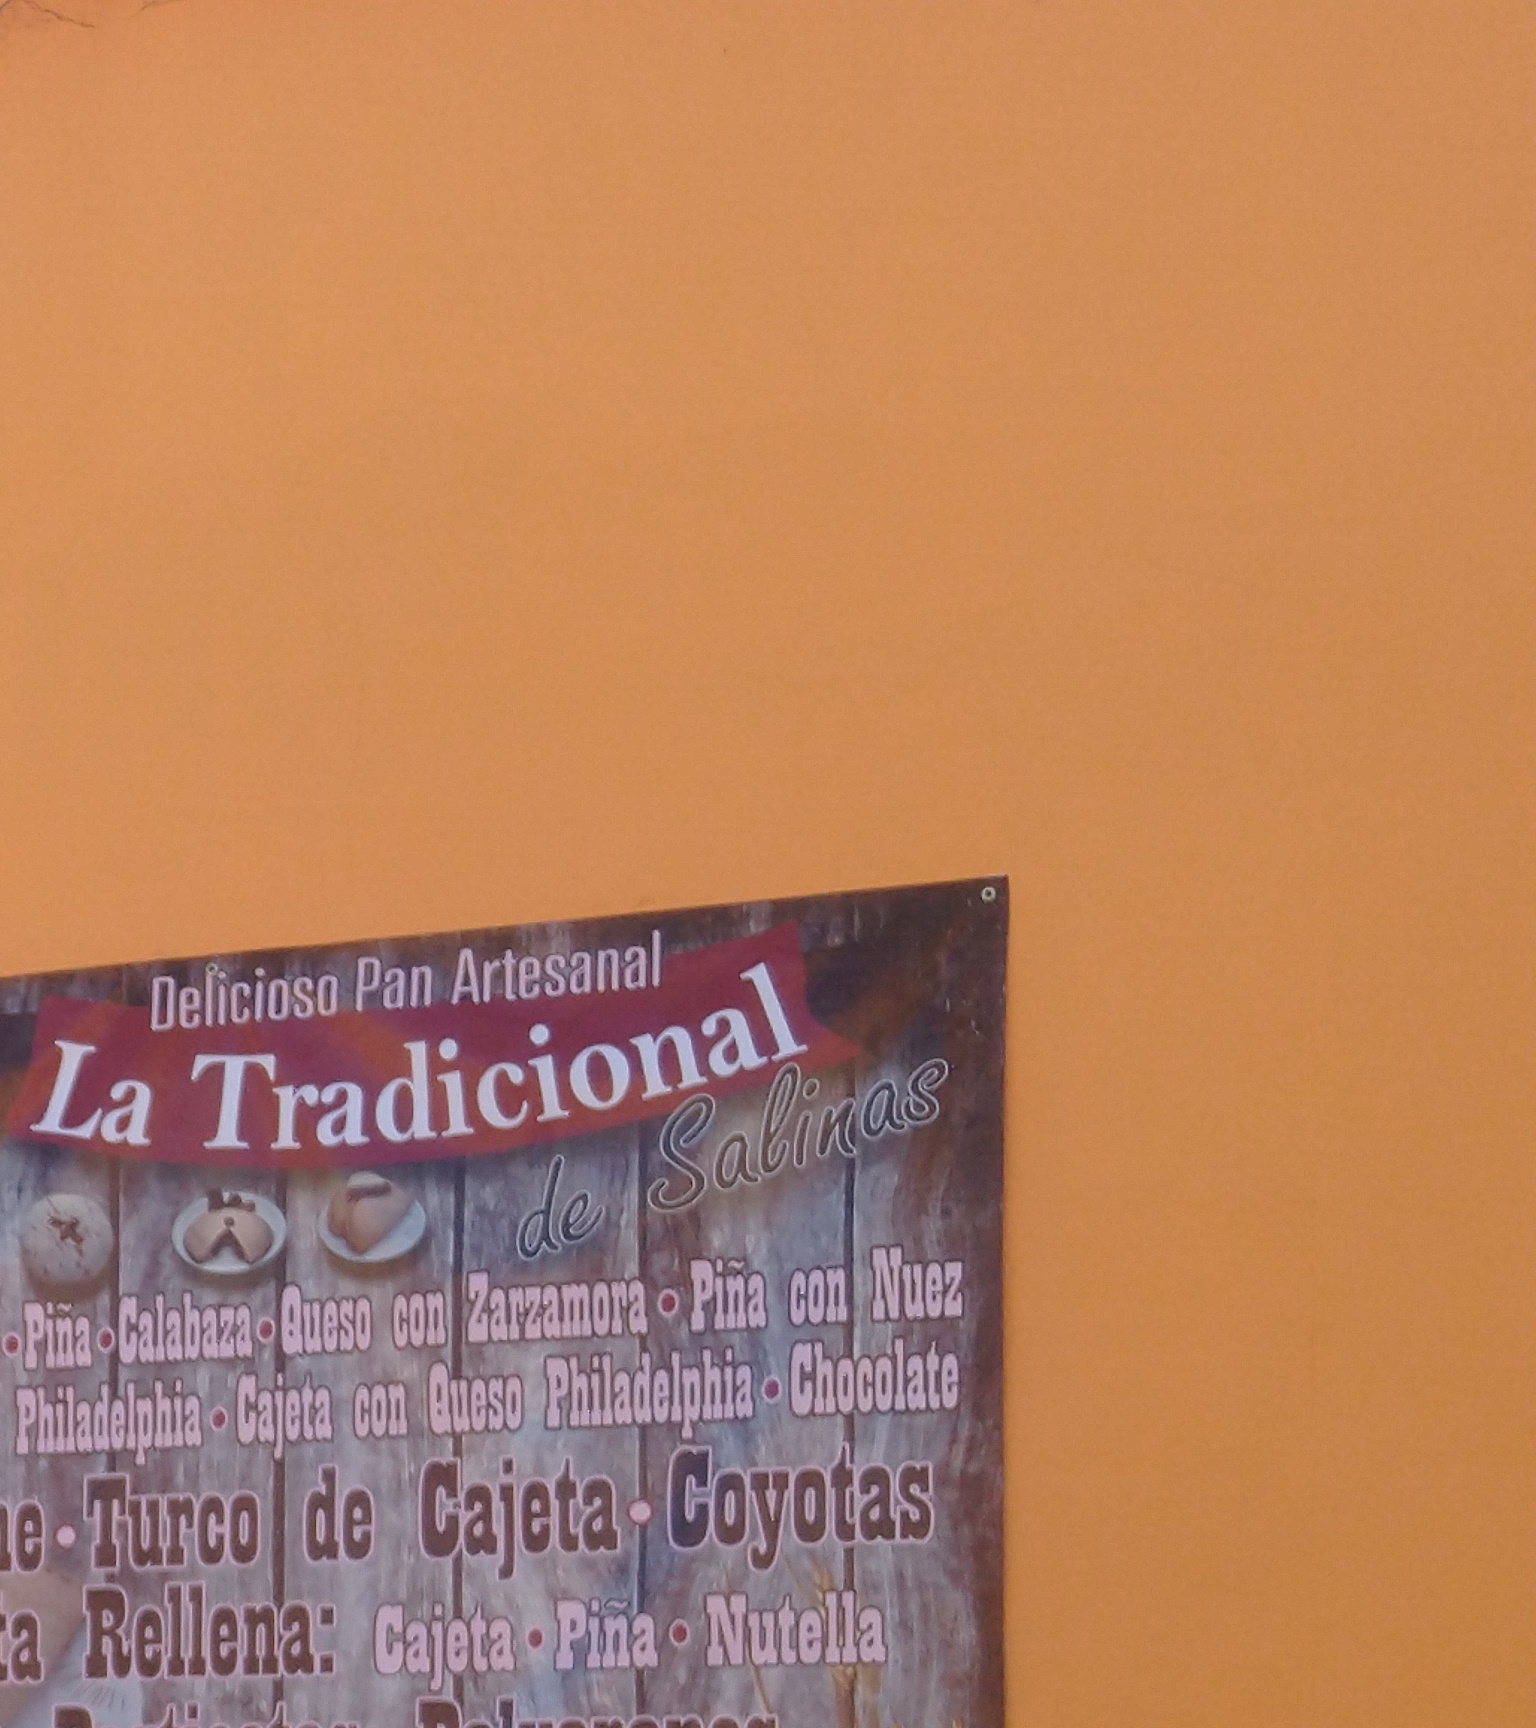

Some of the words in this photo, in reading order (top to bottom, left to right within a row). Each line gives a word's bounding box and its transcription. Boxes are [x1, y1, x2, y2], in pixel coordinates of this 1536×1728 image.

[150, 967, 338, 1032] Delicioso
[354, 956, 432, 1011] Pan
[450, 929, 662, 1005] Artesanal
[30, 1039, 151, 1147] La
[190, 961, 808, 1150] Tradicional
[515, 1154, 606, 1260] de
[648, 1057, 949, 1213] Salinas
[23, 1301, 92, 1370] Piña
[119, 1291, 253, 1363] Calabaza
[280, 1283, 371, 1355] Queso
[392, 1291, 446, 1349] con
[466, 1269, 649, 1343] Zarzamora
[689, 1258, 767, 1333] Piña
[788, 1266, 848, 1326] con
[871, 1245, 964, 1322] Nuez
[15, 1378, 202, 1466] Philadelphia
[236, 1372, 333, 1460] Cajeta
[353, 1382, 409, 1439] con
[428, 1361, 523, 1435] Queso
[545, 1347, 754, 1439] Philadelphia
[789, 1337, 960, 1417] Chocolate
[83, 1472, 261, 1570] Turco
[304, 1463, 375, 1564] de
[419, 1458, 620, 1580] Cajeta
[666, 1441, 933, 1571] Coyotas
[82, 1581, 336, 1680] Rellena:
[374, 1601, 515, 1691] Cajeta
[554, 1599, 659, 1671] Piña
[705, 1590, 887, 1668] Nutella
